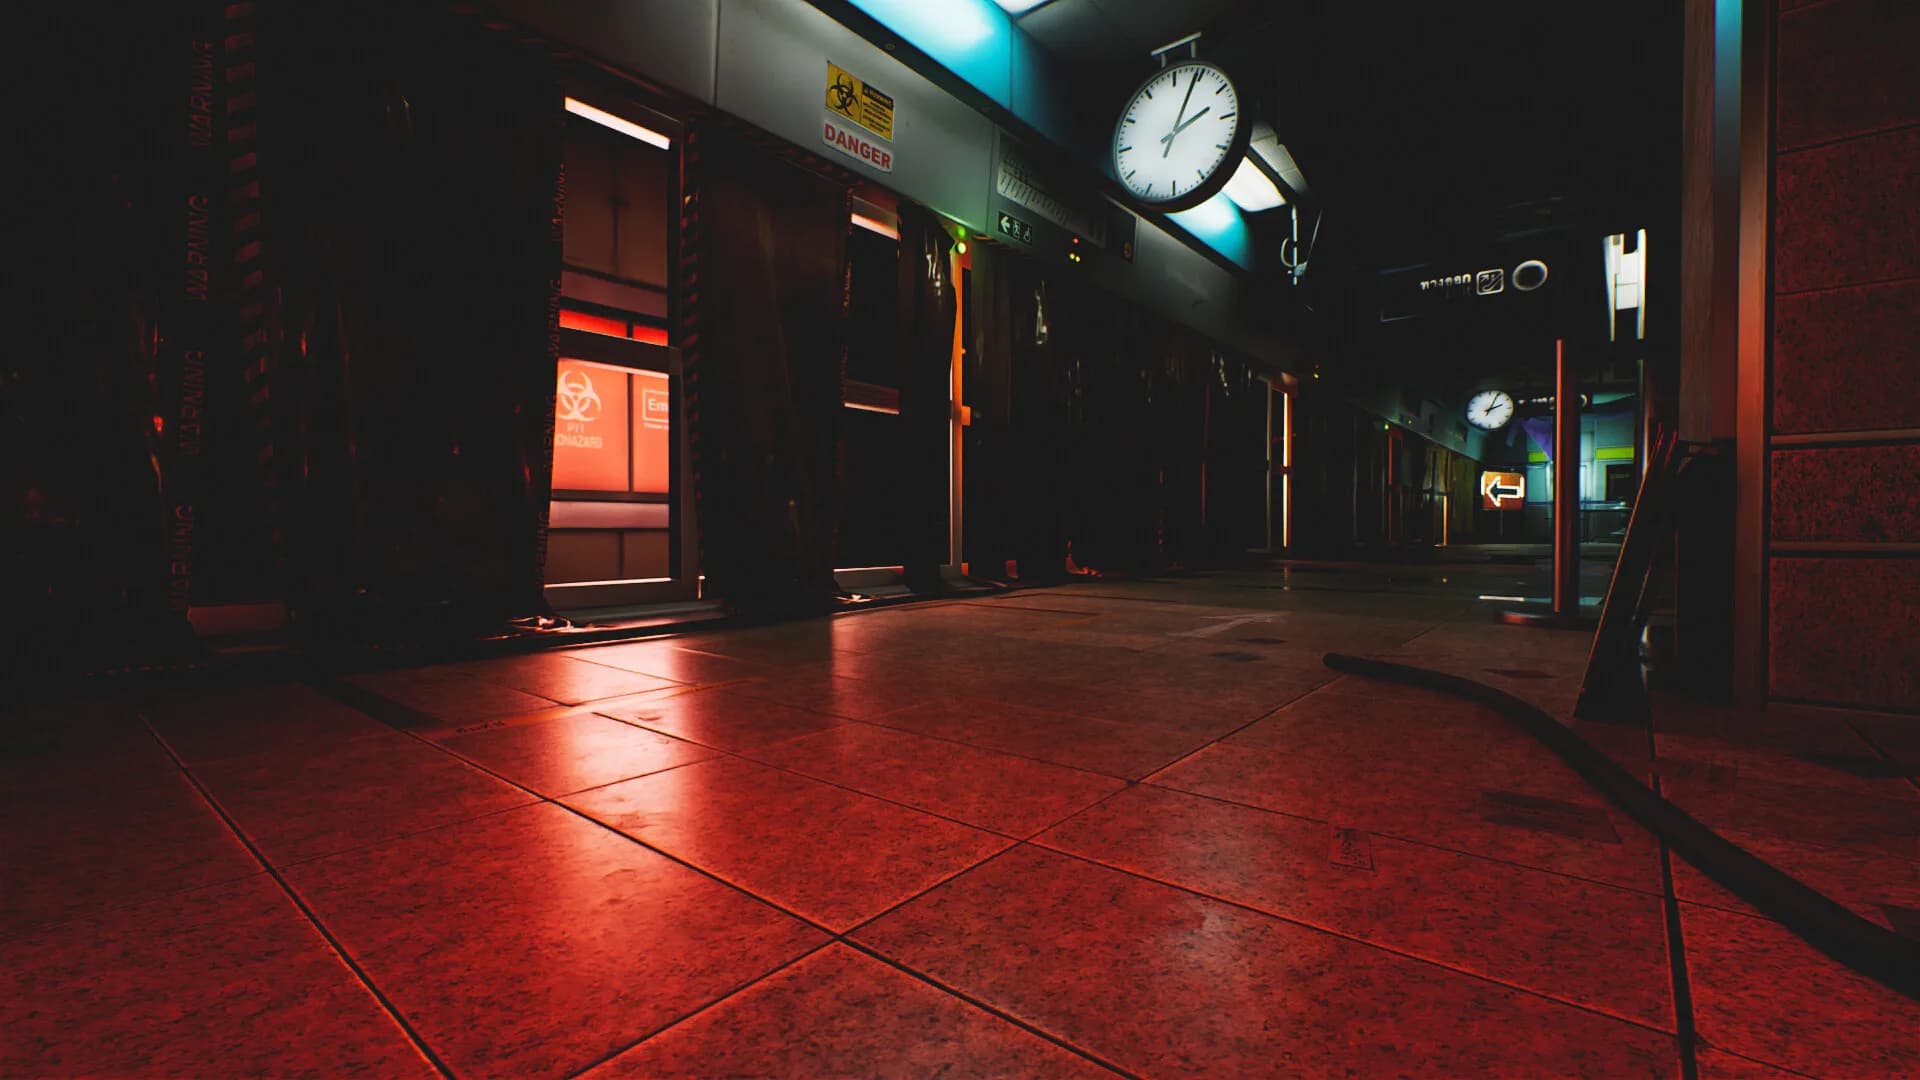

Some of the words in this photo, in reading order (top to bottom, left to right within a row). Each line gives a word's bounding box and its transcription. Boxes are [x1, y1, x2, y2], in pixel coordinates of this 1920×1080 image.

[824, 123, 891, 169] DANGER
[185, 191, 209, 303] WARNING
[176, 351, 204, 457] WARNING
